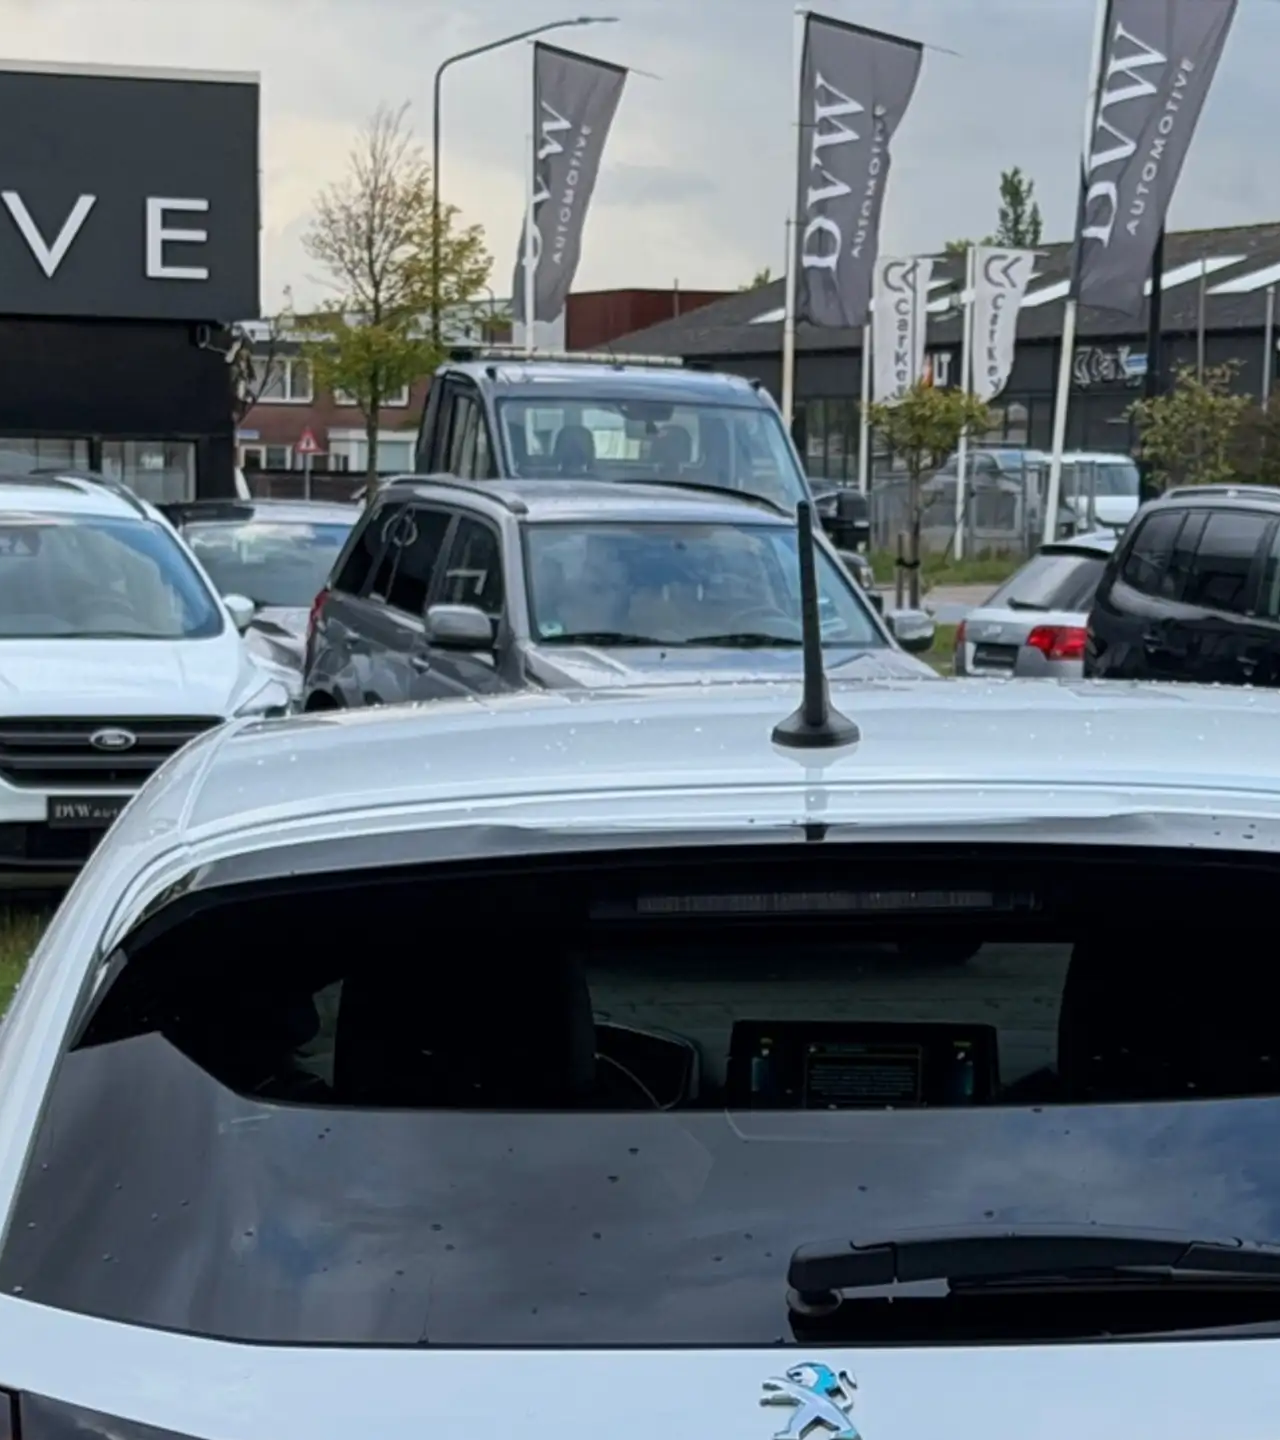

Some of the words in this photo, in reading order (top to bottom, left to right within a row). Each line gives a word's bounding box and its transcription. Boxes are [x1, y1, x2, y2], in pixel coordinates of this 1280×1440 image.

[552, 124, 592, 263] AUTOMOTIVE
[802, 71, 865, 272] DVW
[851, 104, 887, 259] AUTOMOTIVE
[1082, 21, 1167, 248] DVW
[1126, 57, 1195, 236] AUTOMOTIVE
